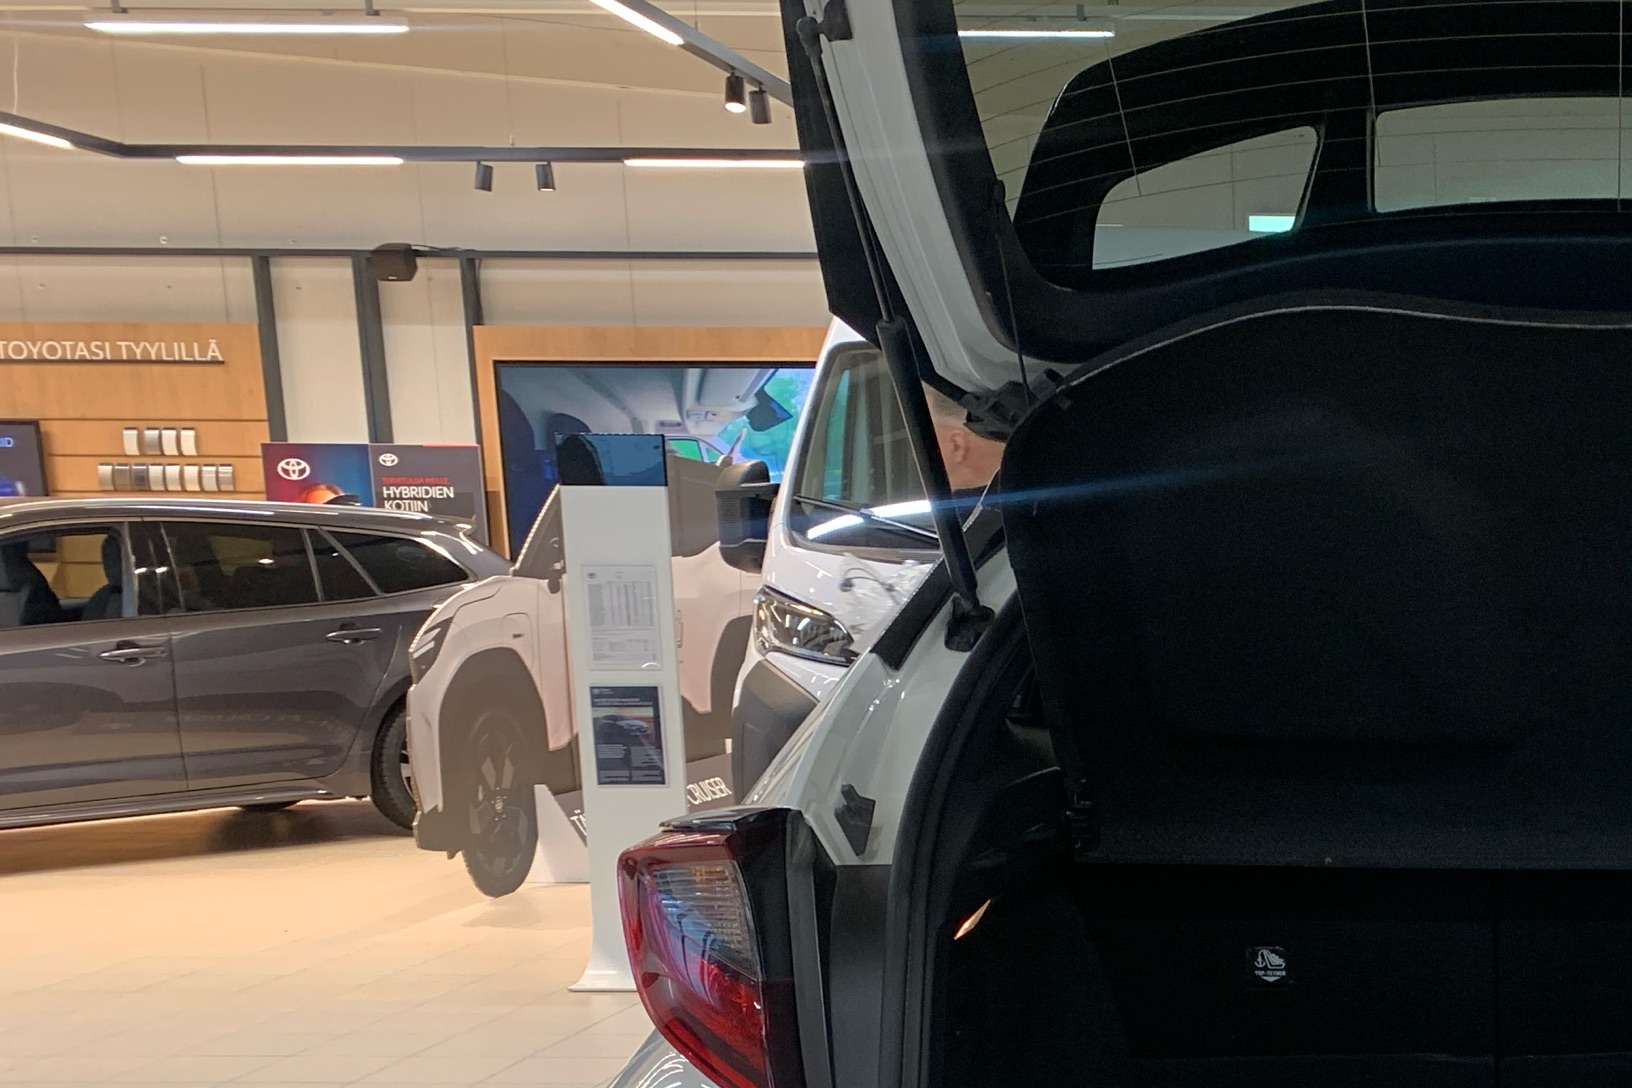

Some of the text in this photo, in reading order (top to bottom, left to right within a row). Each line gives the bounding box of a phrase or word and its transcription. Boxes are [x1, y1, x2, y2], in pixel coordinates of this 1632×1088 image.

[0, 339, 224, 361] TOYOTASI TYYLILLÄ
[382, 486, 454, 499] HYBRIDIEN
[384, 500, 429, 512] KOTIIN
